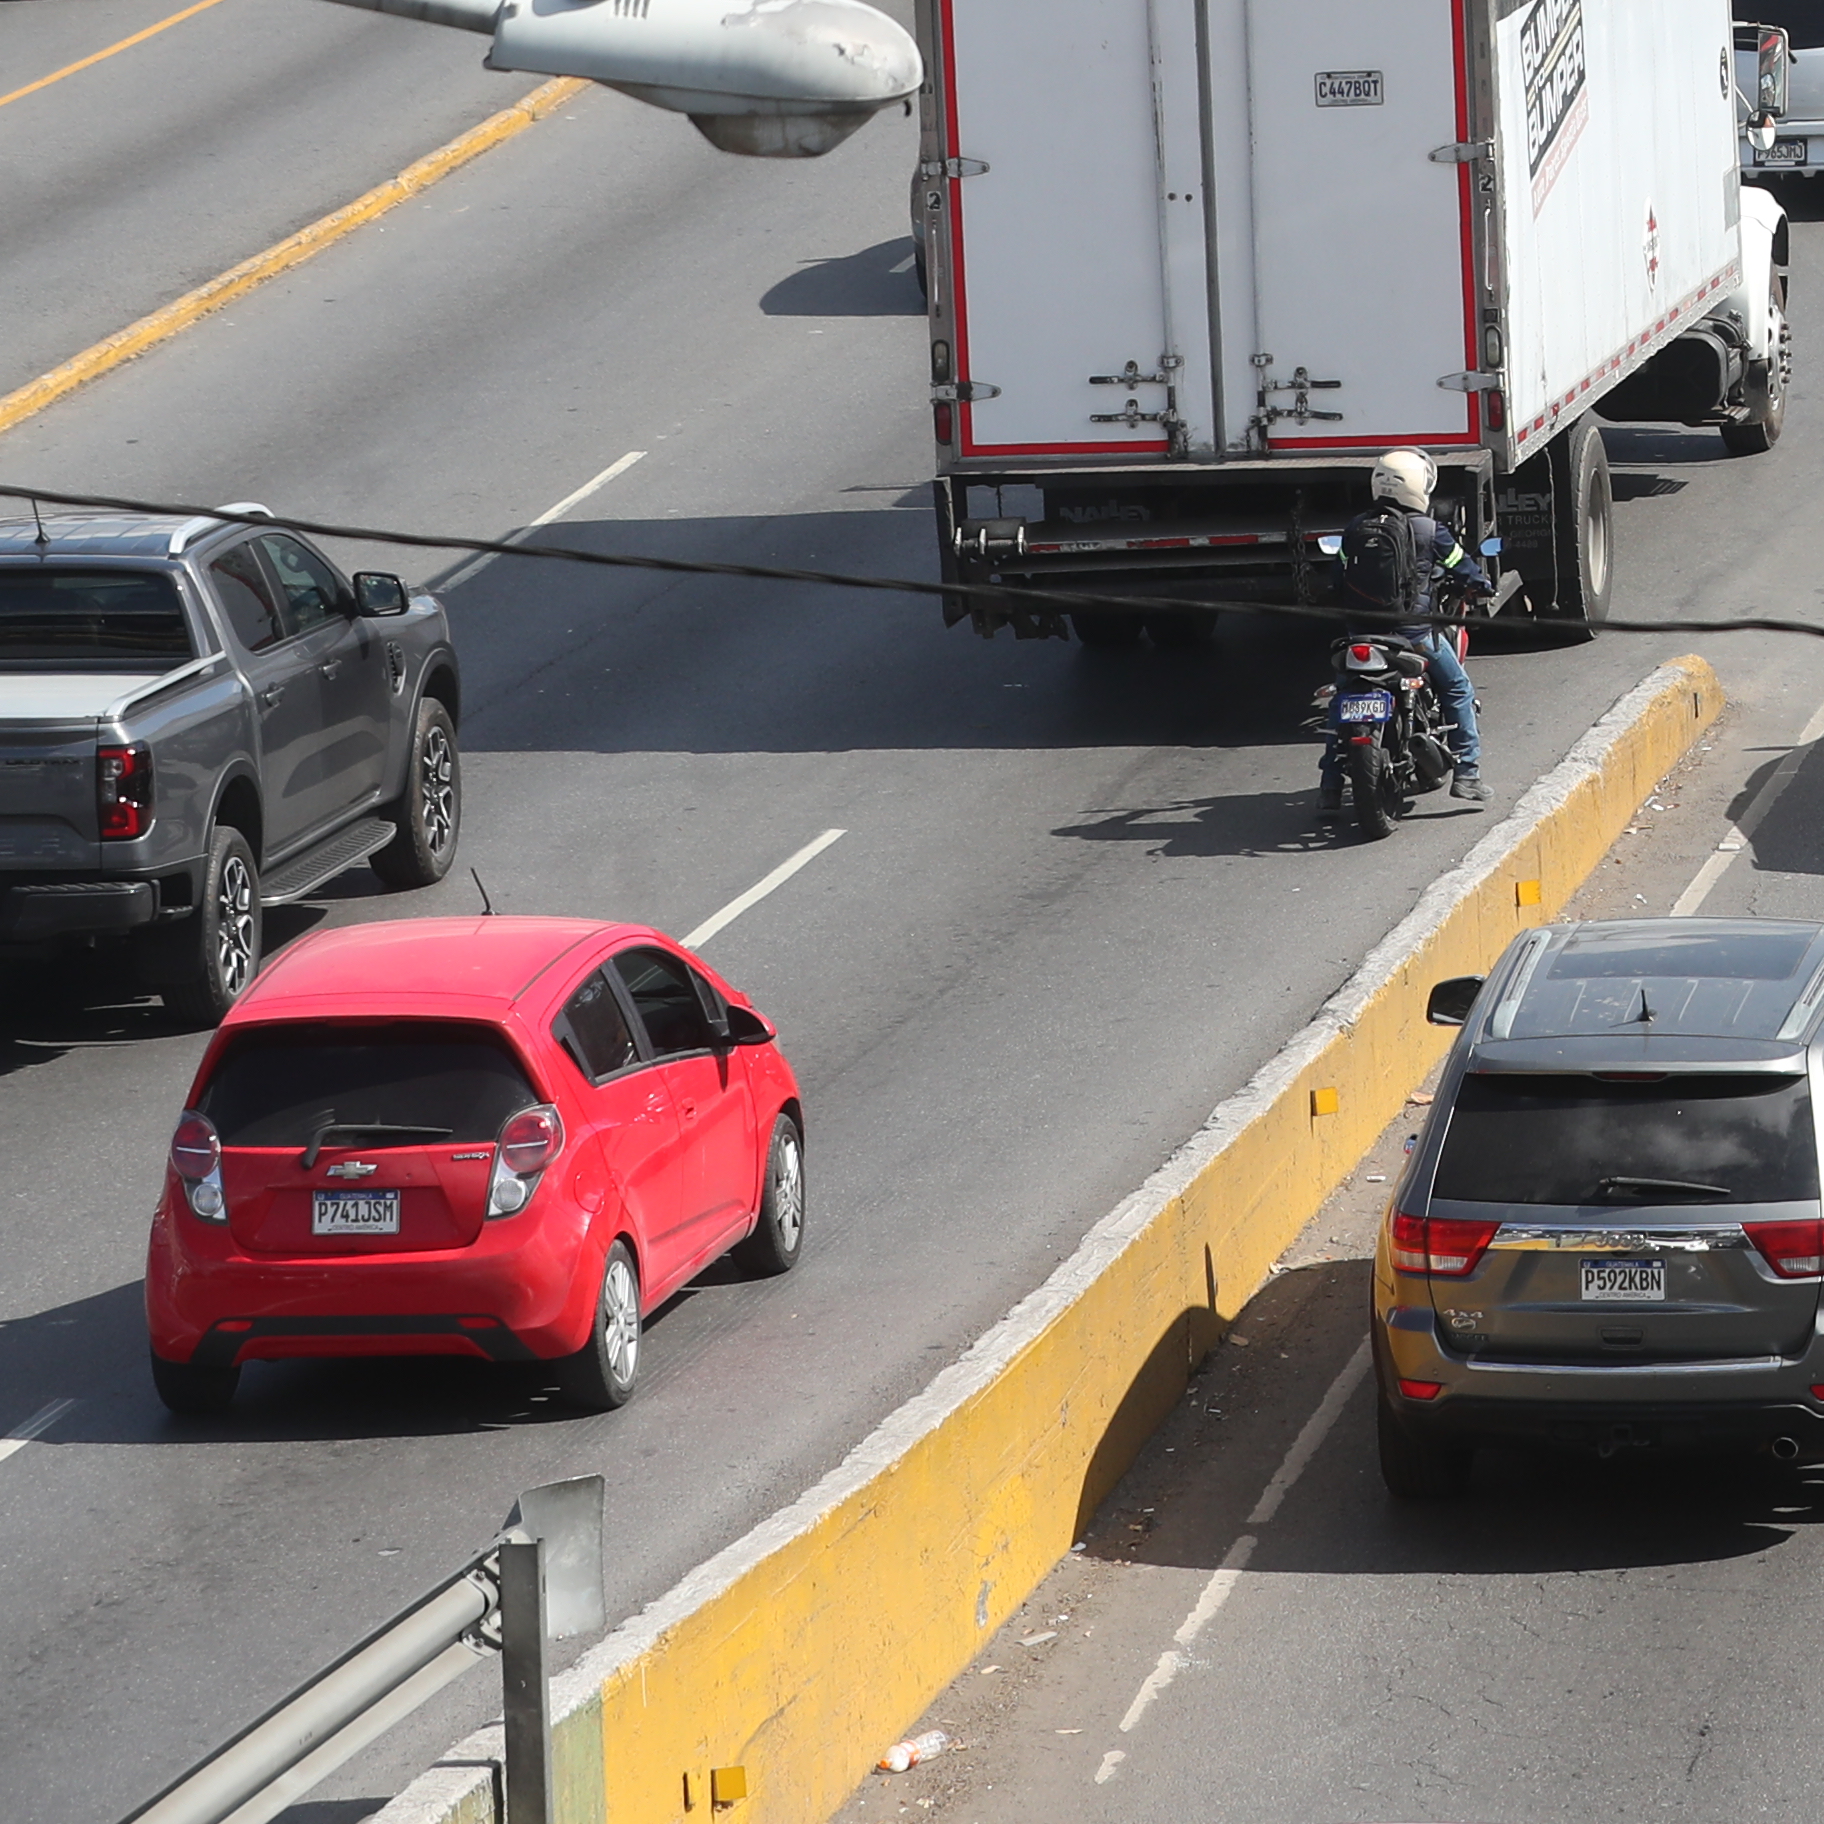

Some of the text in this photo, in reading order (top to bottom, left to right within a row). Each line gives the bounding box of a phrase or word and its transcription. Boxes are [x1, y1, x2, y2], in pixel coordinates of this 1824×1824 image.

[1318, 78, 1380, 100] C447BQT
[1527, 37, 1586, 168] BUMPER
[1481, 175, 1493, 192] 2
[928, 192, 942, 211] 2
[318, 1201, 395, 1224] P741JSM
[1583, 1268, 1662, 1291] P592KBN
